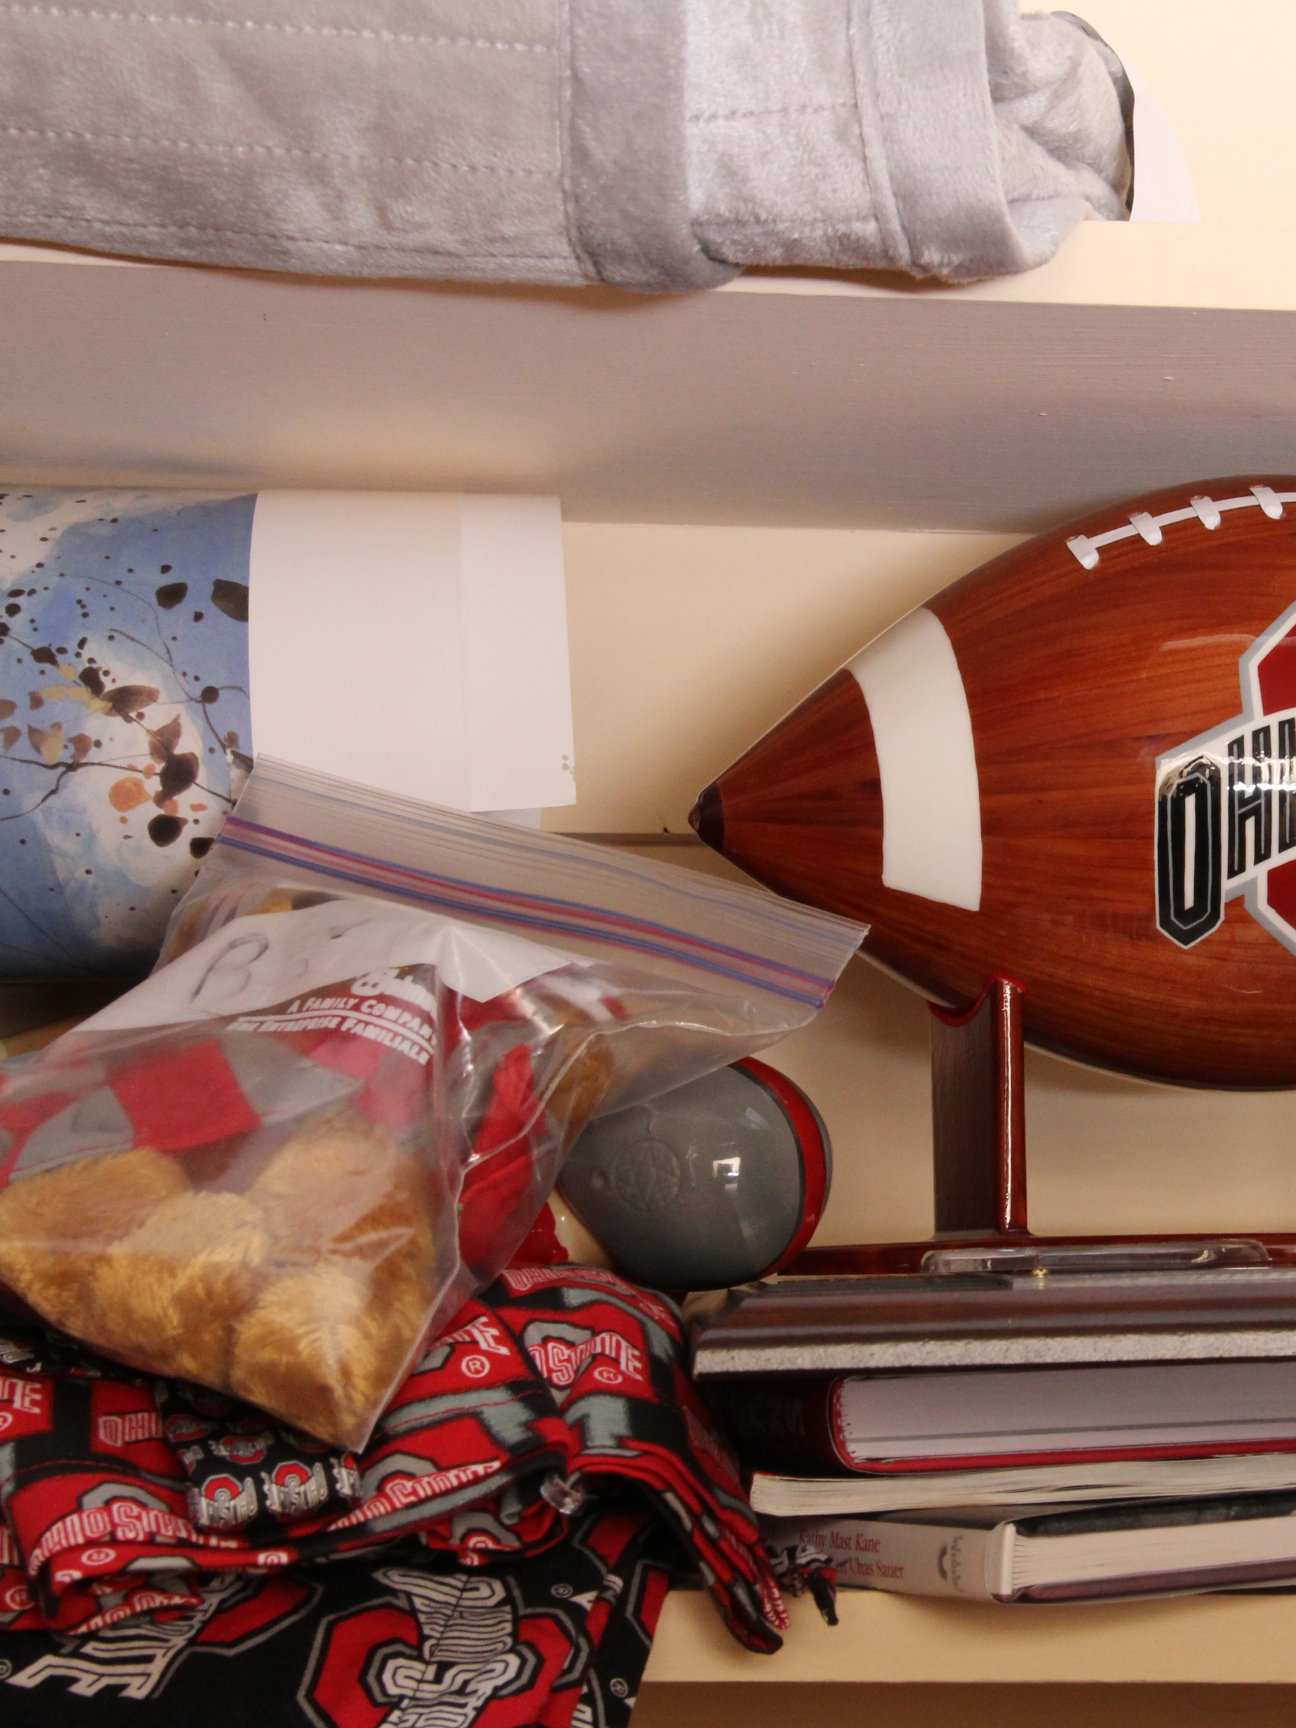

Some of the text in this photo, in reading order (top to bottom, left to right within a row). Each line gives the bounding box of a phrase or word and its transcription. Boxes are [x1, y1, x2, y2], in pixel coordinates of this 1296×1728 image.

[303, 997, 361, 1012] FAMILY
[340, 1017, 431, 1066] FAMILIALE
[828, 1531, 852, 1551] Mast
[855, 1532, 881, 1553] Kane
[875, 1561, 905, 1580] Sauer
